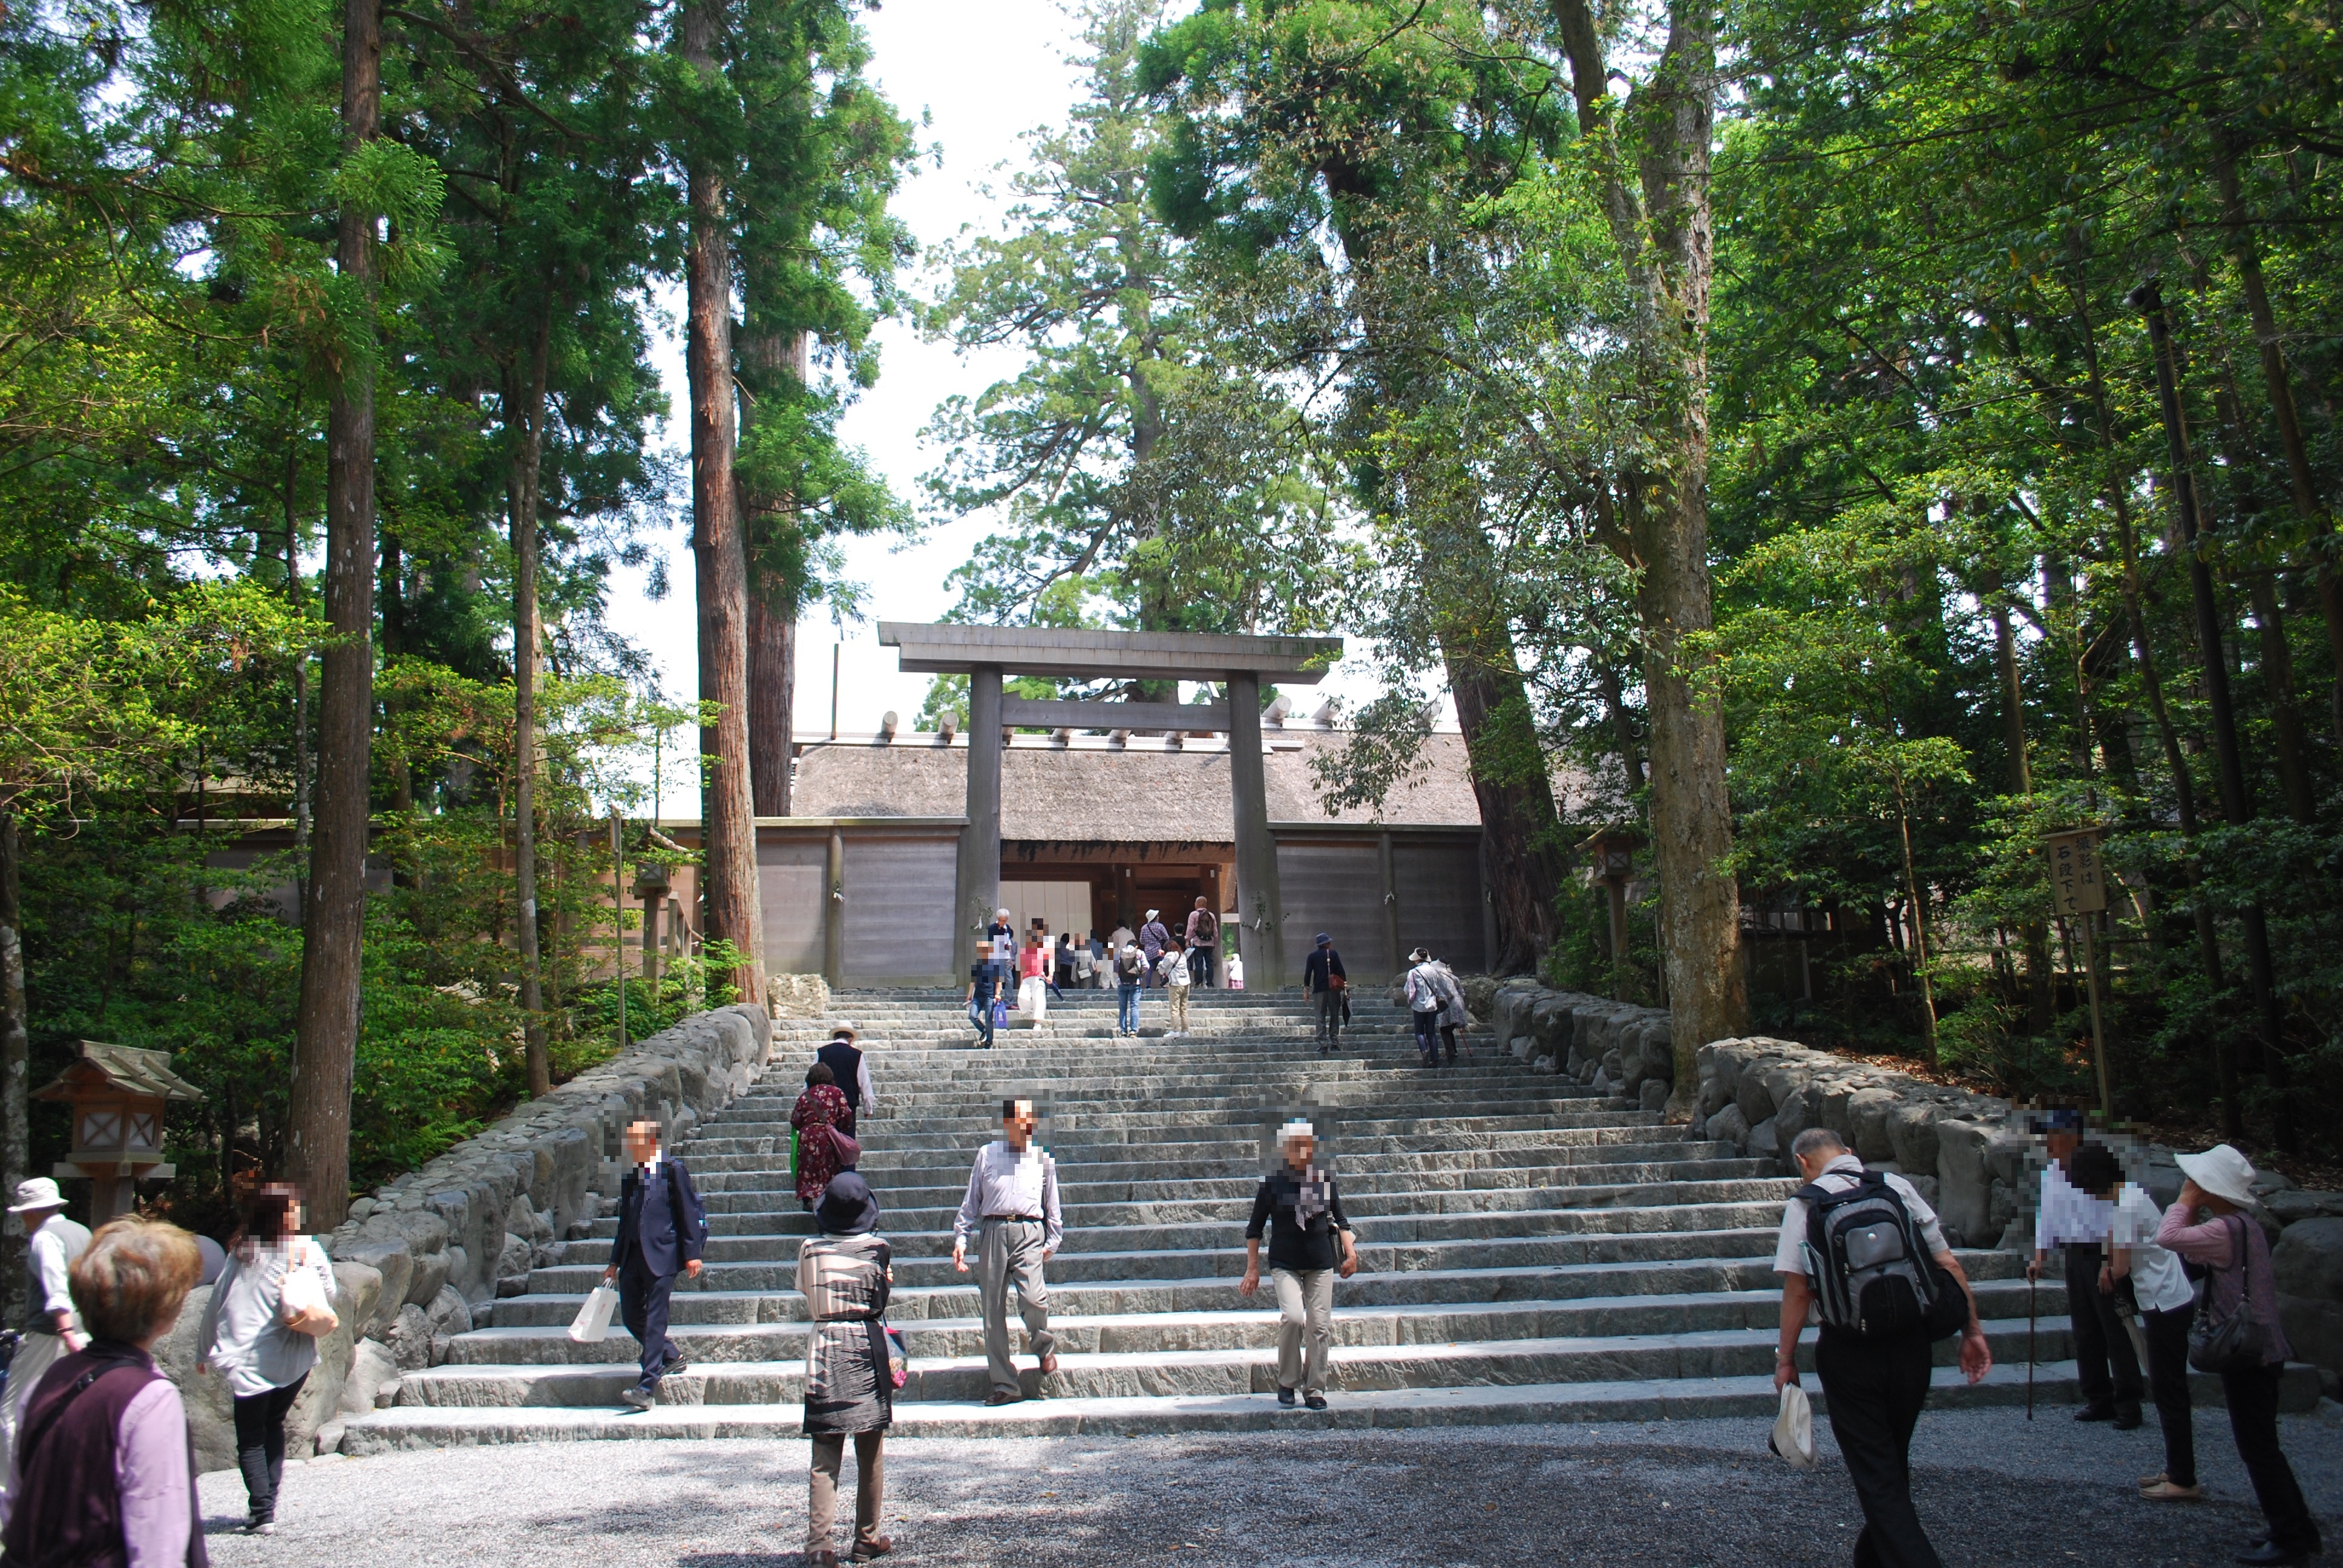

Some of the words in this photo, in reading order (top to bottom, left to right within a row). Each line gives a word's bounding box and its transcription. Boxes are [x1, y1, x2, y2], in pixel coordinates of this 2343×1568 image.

[2057, 846, 2077, 909] 石段下で
[2076, 836, 2093, 885] 撮影は
